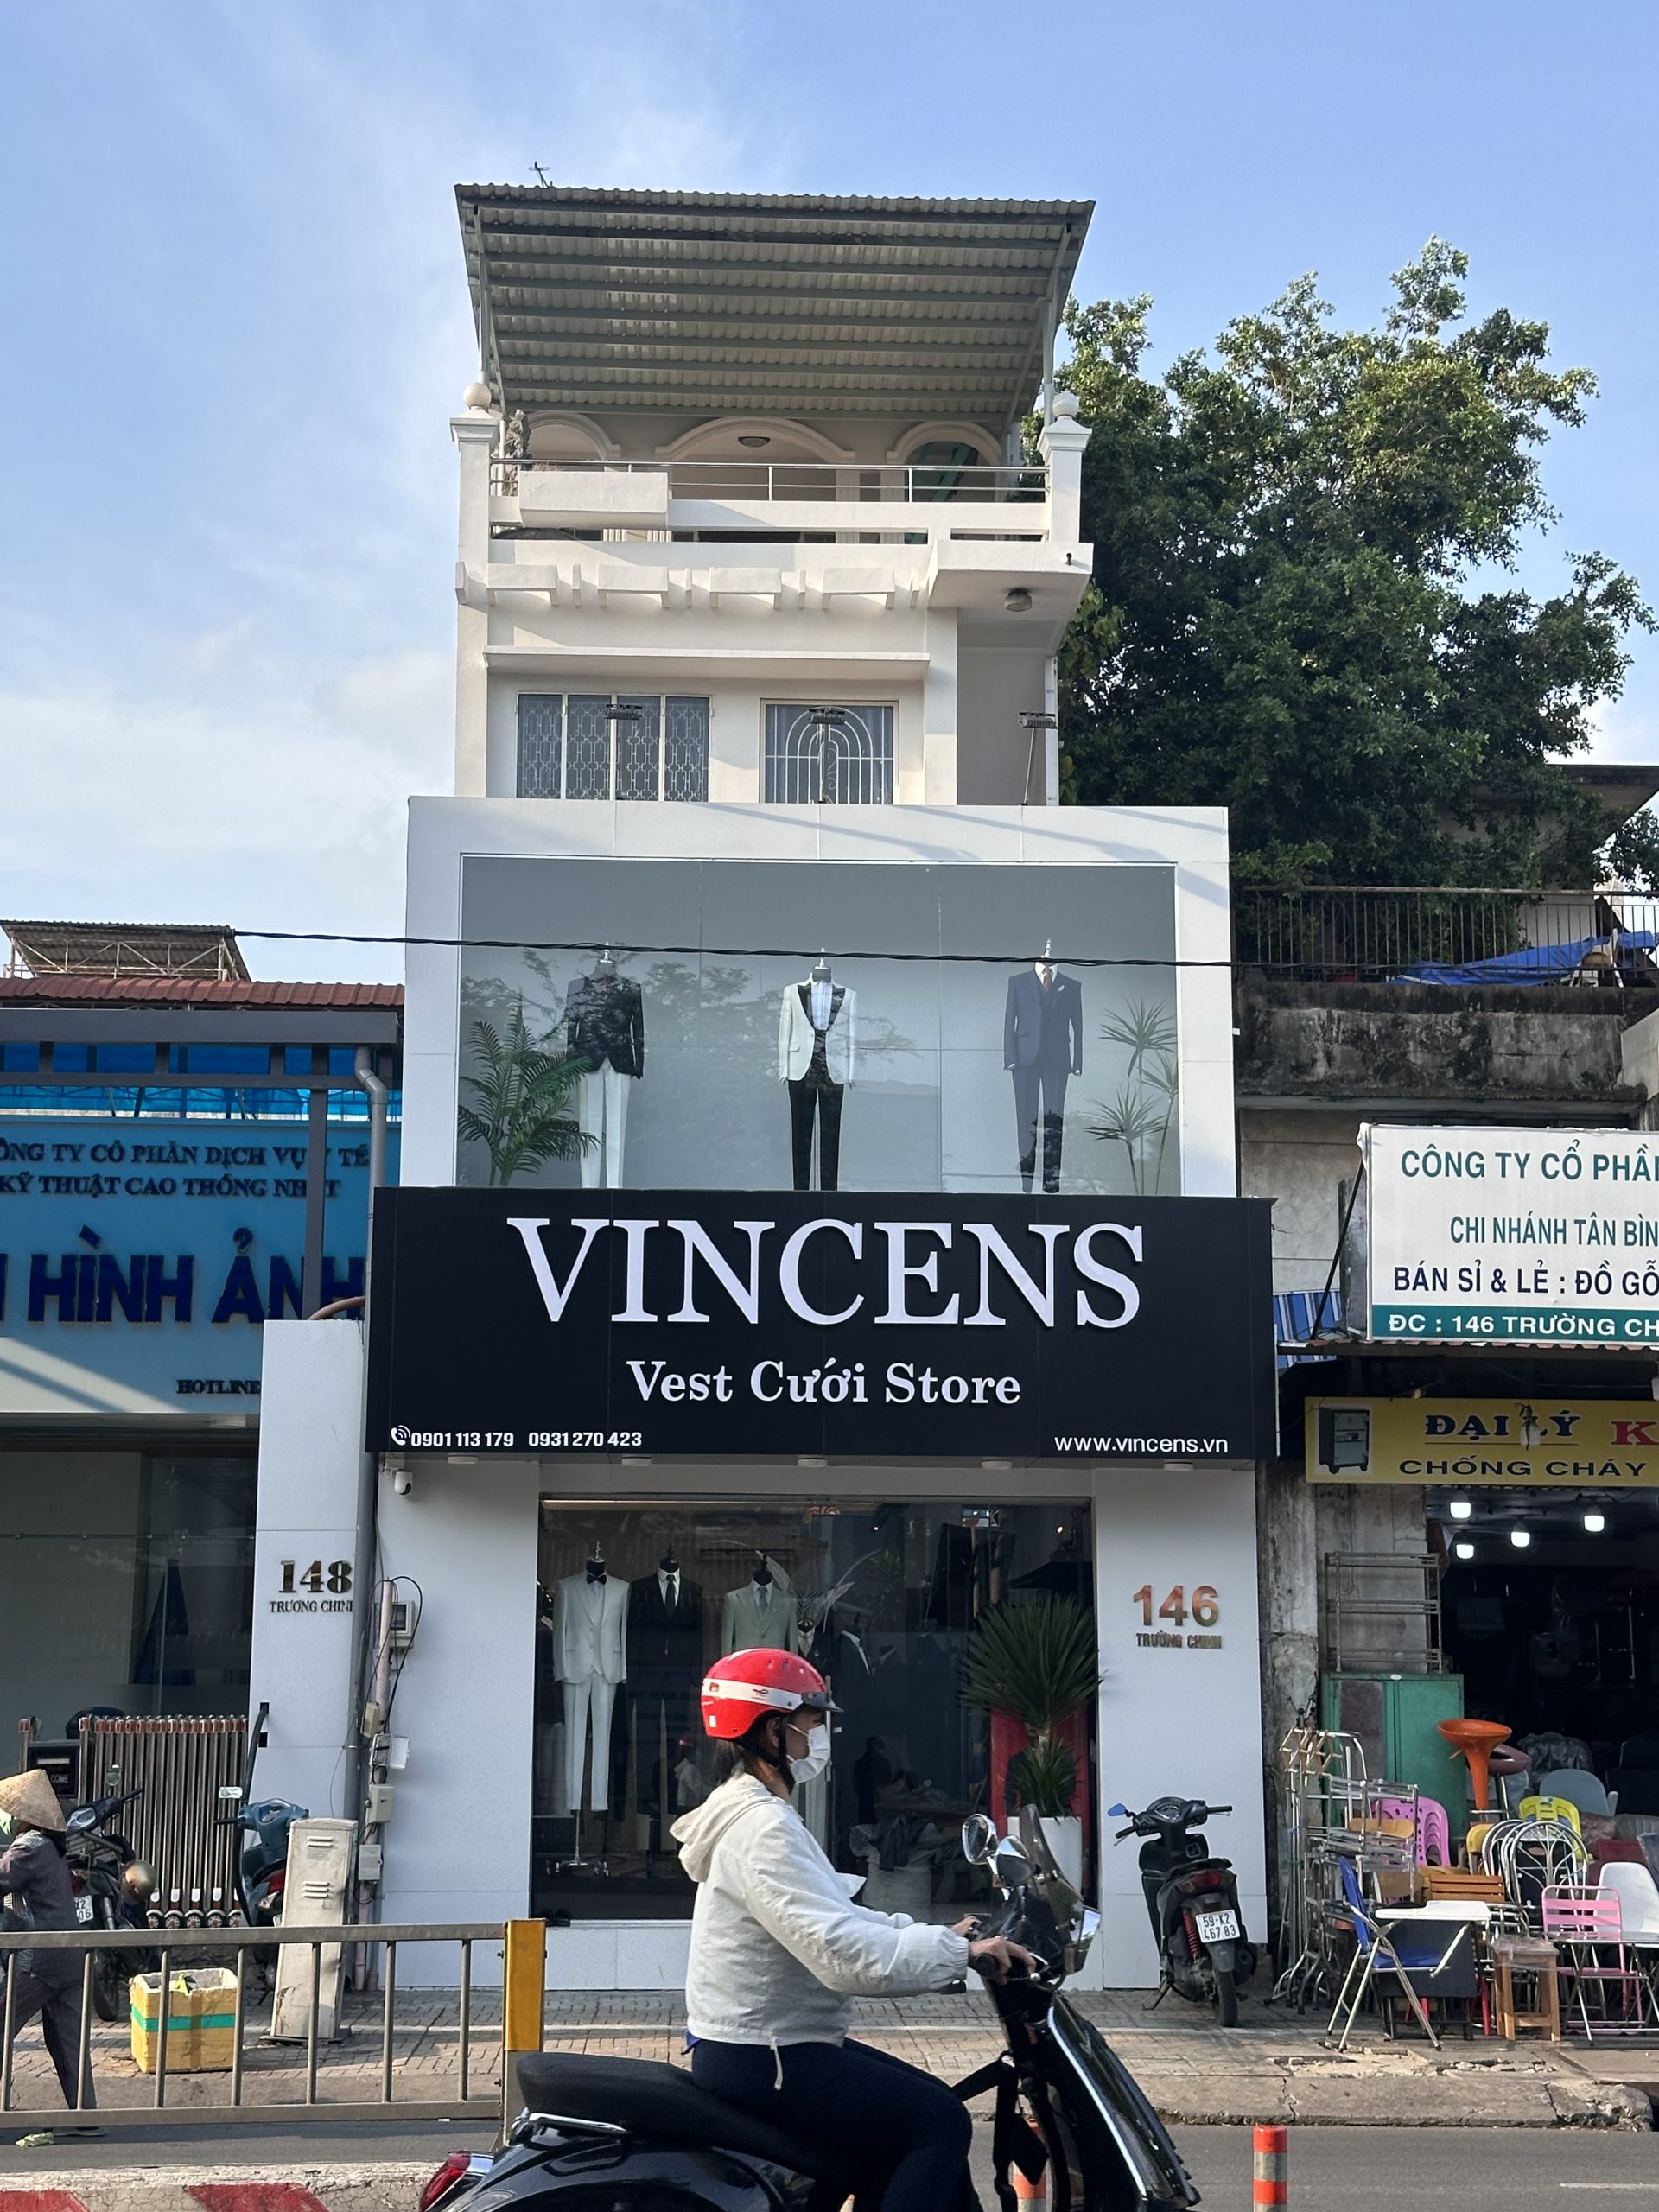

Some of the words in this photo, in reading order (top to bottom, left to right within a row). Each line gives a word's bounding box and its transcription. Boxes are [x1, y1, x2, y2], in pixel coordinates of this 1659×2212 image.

[52, 1143, 86, 1162] TY
[205, 1146, 265, 1168] DỊCH
[1401, 1143, 1484, 1178] CÔNG
[1495, 1152, 1530, 1179] TY
[1541, 1139, 1582, 1180] CỔ
[39, 1173, 121, 1198] THUẬT
[124, 1177, 176, 1196] CAO
[272, 1179, 341, 1198] NHT
[1451, 1216, 1485, 1243] CHI
[1492, 1211, 1567, 1245] NHÁNH
[1574, 1212, 1616, 1246] TÂN
[28, 1224, 194, 1323] HÌNH
[506, 1218, 1143, 1329] VINCENS
[1394, 1261, 1448, 1292] BÁN
[1458, 1259, 1482, 1293] SỈ
[1491, 1268, 1508, 1294] &
[1517, 1259, 1549, 1294] LẺ
[1575, 1259, 1613, 1296] ĐỒ
[1622, 1259, 1659, 1297] GỖ
[1389, 1314, 1427, 1332] ĐC
[1452, 1315, 1495, 1333] 146
[1502, 1313, 1617, 1337] TRƯỜNG
[176, 1379, 262, 1395] HOTLINE
[626, 1360, 734, 1402] Vest
[750, 1357, 868, 1403] Cưới
[885, 1362, 1021, 1405] Store
[410, 1432, 452, 1447] 0901
[455, 1432, 481, 1447] 113
[485, 1432, 515, 1447] 179
[528, 1431, 569, 1447] 0931
[572, 1431, 605, 1447] 270
[607, 1431, 643, 1447] 423
[1424, 1414, 1510, 1440] ĐẠI
[1054, 1436, 1229, 1453] www.vincens.vn
[1399, 1455, 1532, 1476] CHỐNG
[1545, 1459, 1647, 1477] CHÁY
[278, 1560, 353, 1594] 148
[1133, 1584, 1219, 1627] 146
